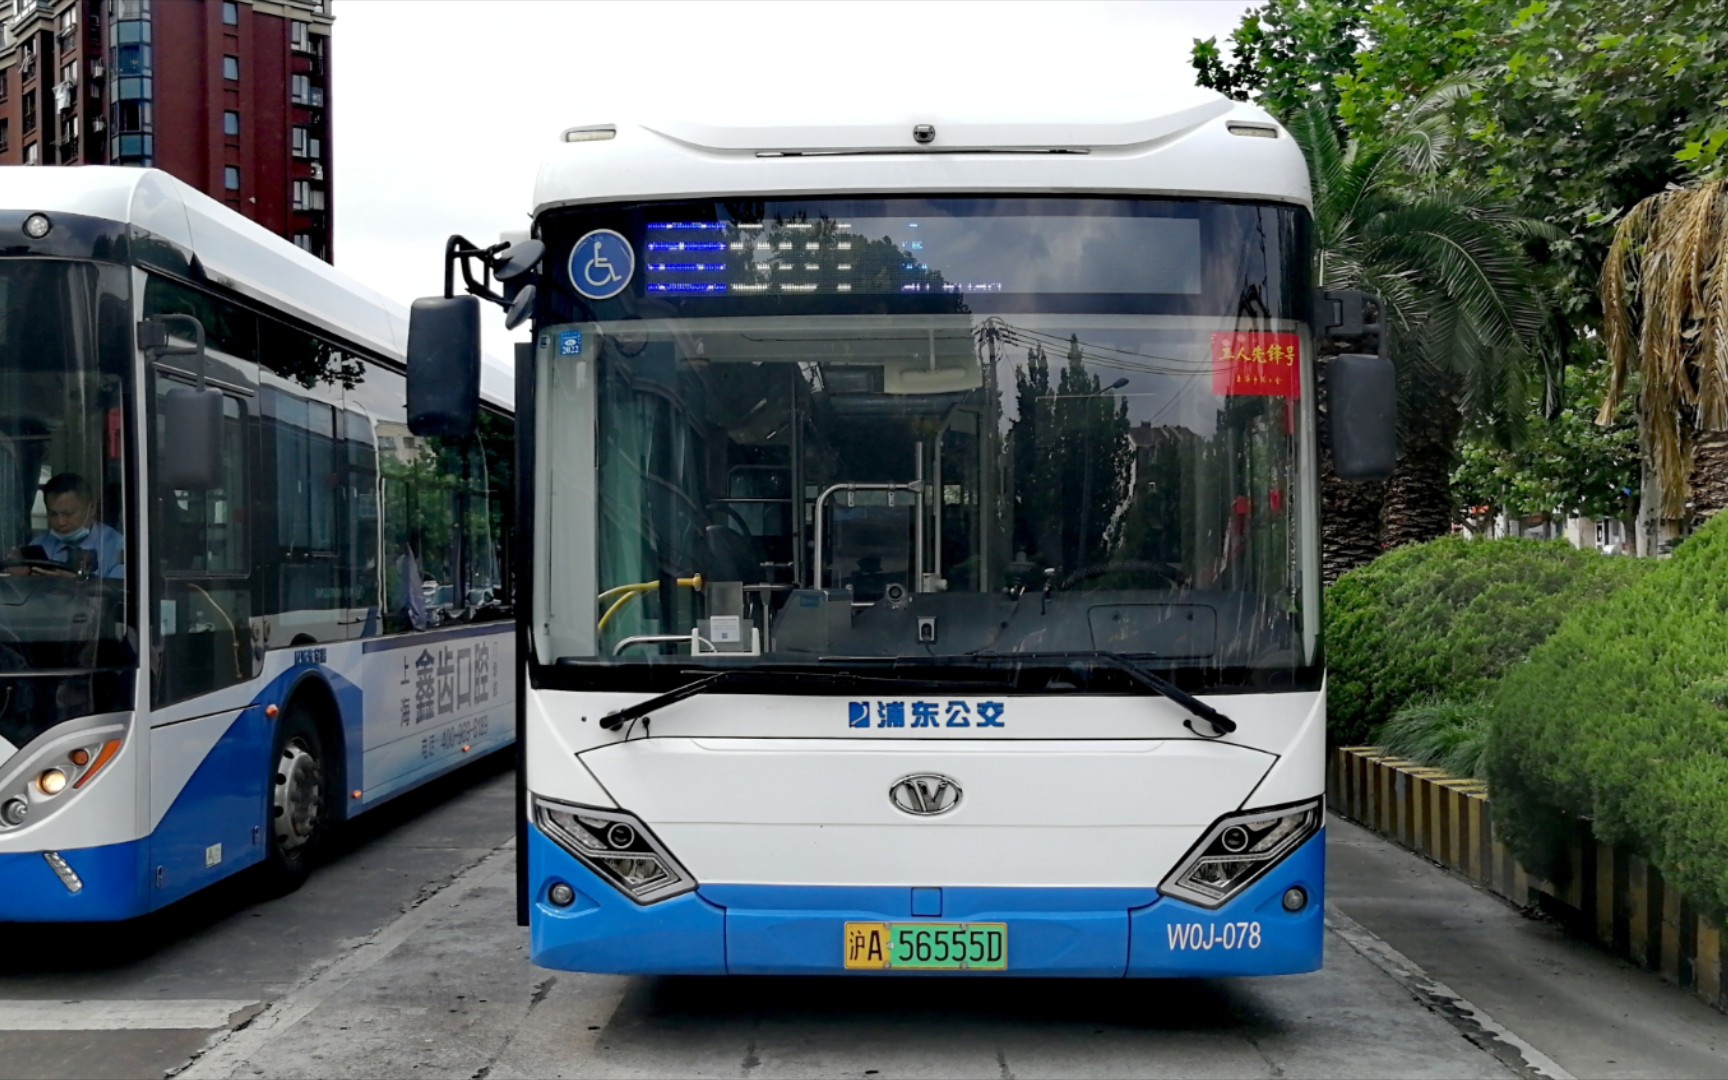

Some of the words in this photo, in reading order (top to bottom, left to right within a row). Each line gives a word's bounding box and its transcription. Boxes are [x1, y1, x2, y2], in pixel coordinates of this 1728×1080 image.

[415, 642, 489, 725] 鑫齿口腔
[877, 700, 1005, 728] 浦东公交
[850, 930, 883, 961] 沪A
[899, 930, 1002, 961] 56555D
